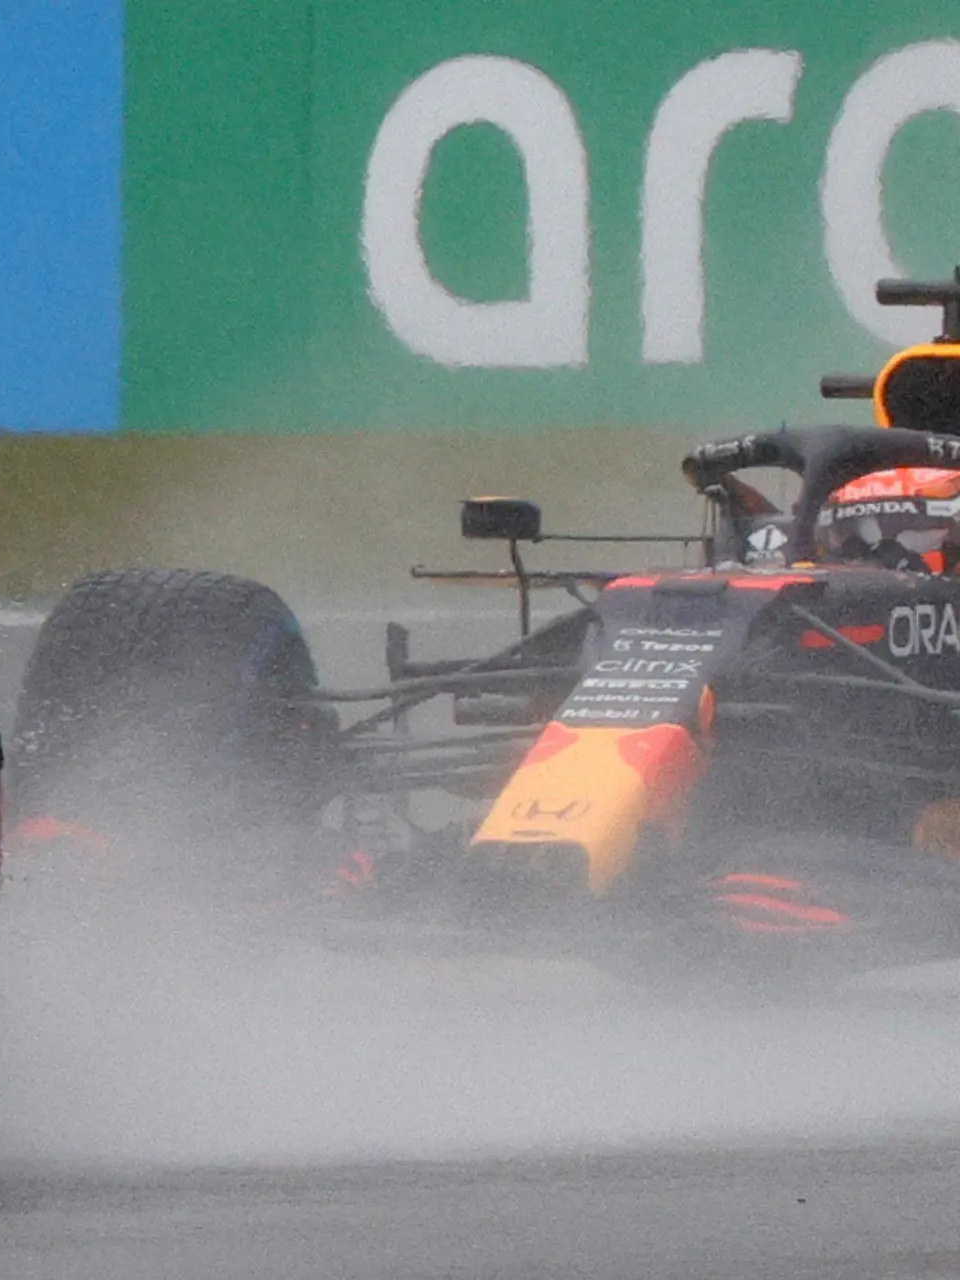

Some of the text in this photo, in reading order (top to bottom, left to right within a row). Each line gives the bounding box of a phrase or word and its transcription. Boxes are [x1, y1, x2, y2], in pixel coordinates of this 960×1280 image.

[836, 501, 919, 520] HONDA
[888, 603, 960, 657] ORA
[596, 657, 703, 674] citrix
